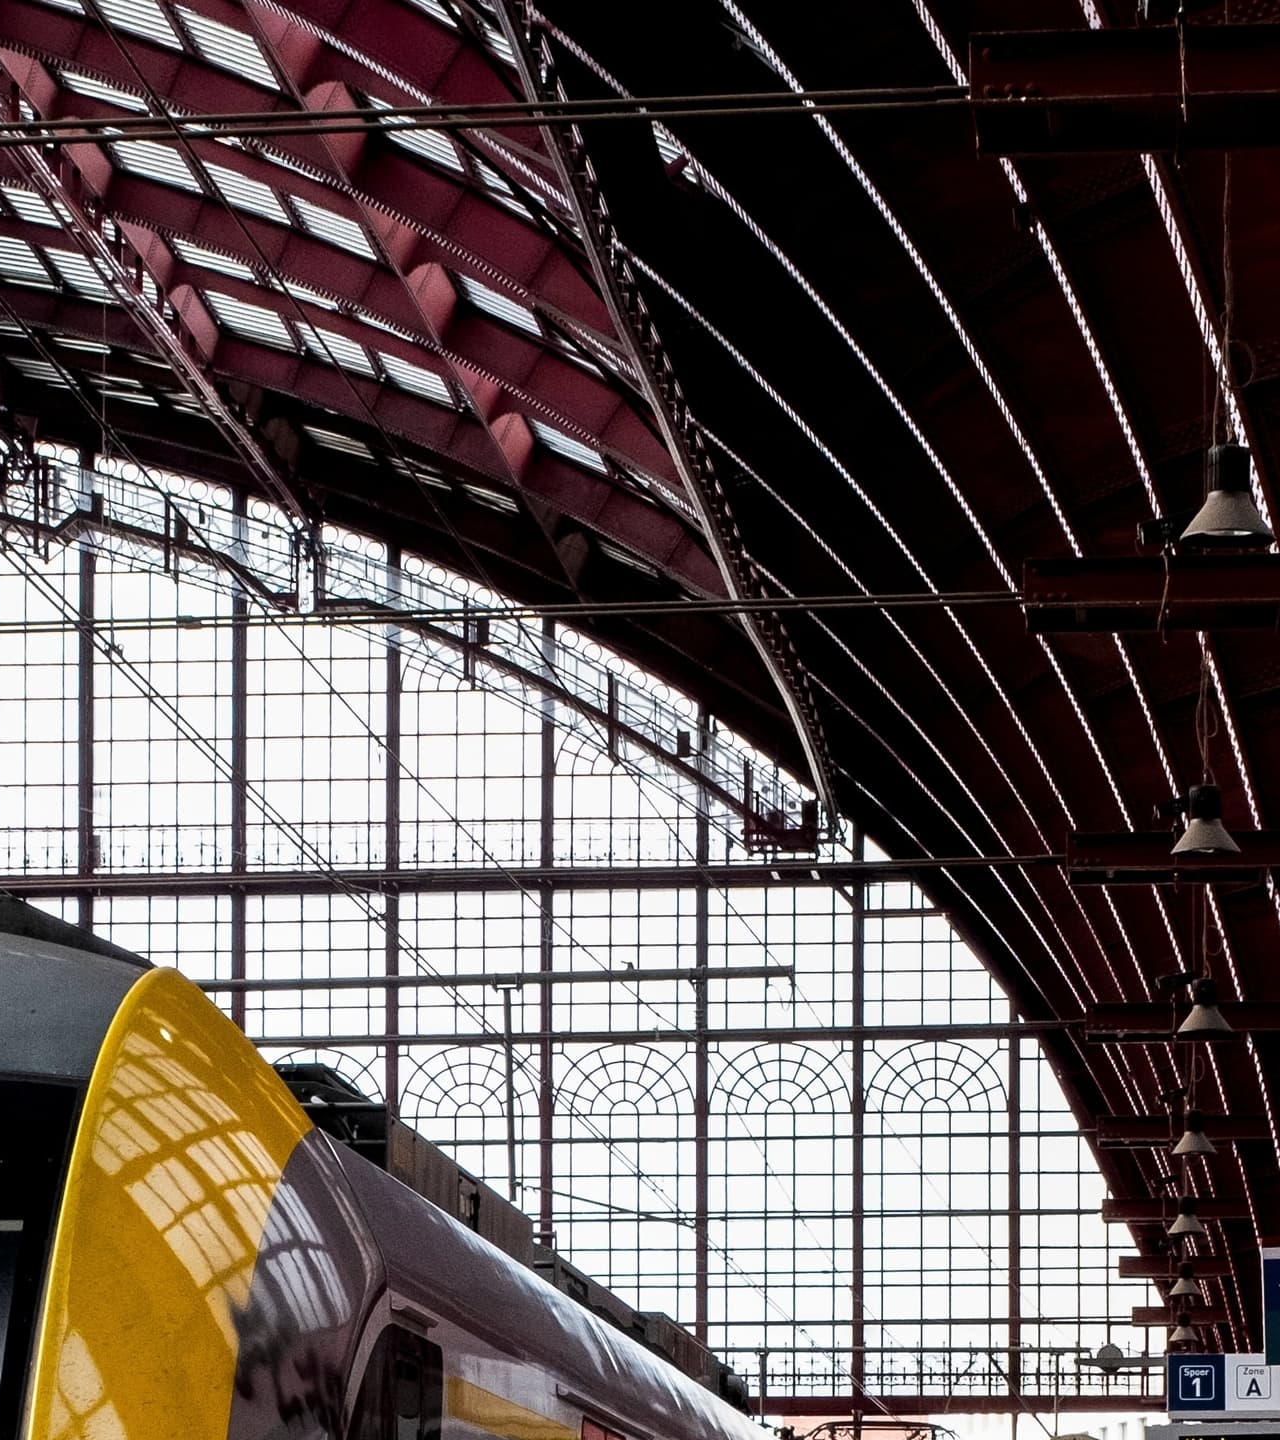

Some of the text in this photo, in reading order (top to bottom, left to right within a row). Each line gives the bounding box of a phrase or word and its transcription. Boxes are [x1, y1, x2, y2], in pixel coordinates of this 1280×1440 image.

[1243, 1367, 1265, 1376] Zone
[1191, 1377, 1201, 1397] 1
[1246, 1377, 1262, 1397] A
